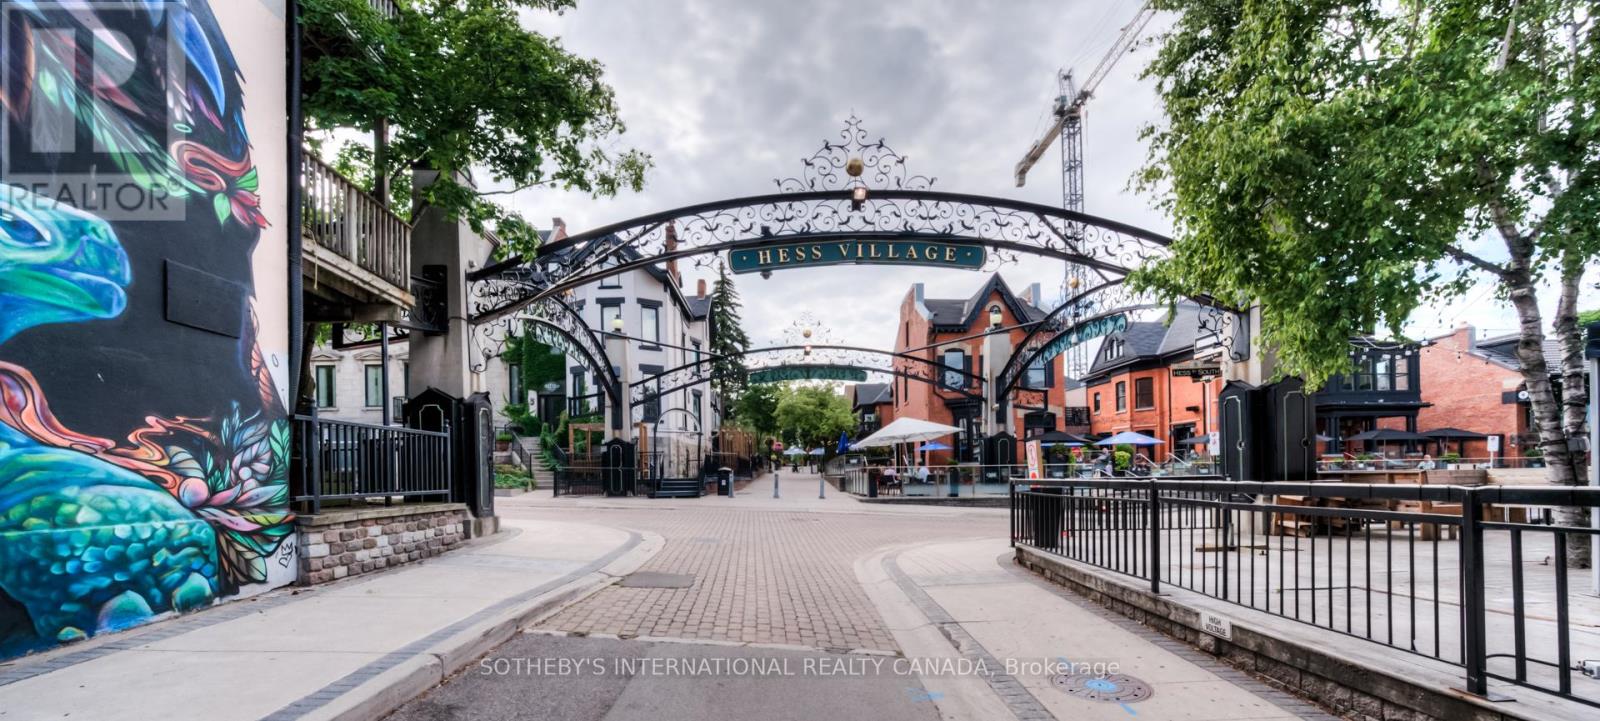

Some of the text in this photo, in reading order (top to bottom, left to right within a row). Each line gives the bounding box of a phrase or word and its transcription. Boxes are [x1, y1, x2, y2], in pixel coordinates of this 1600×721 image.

[758, 243, 958, 264] HESS VILLAGE
[1208, 615, 1222, 627] HIGH
[1205, 623, 1227, 637] VOLTAGE
